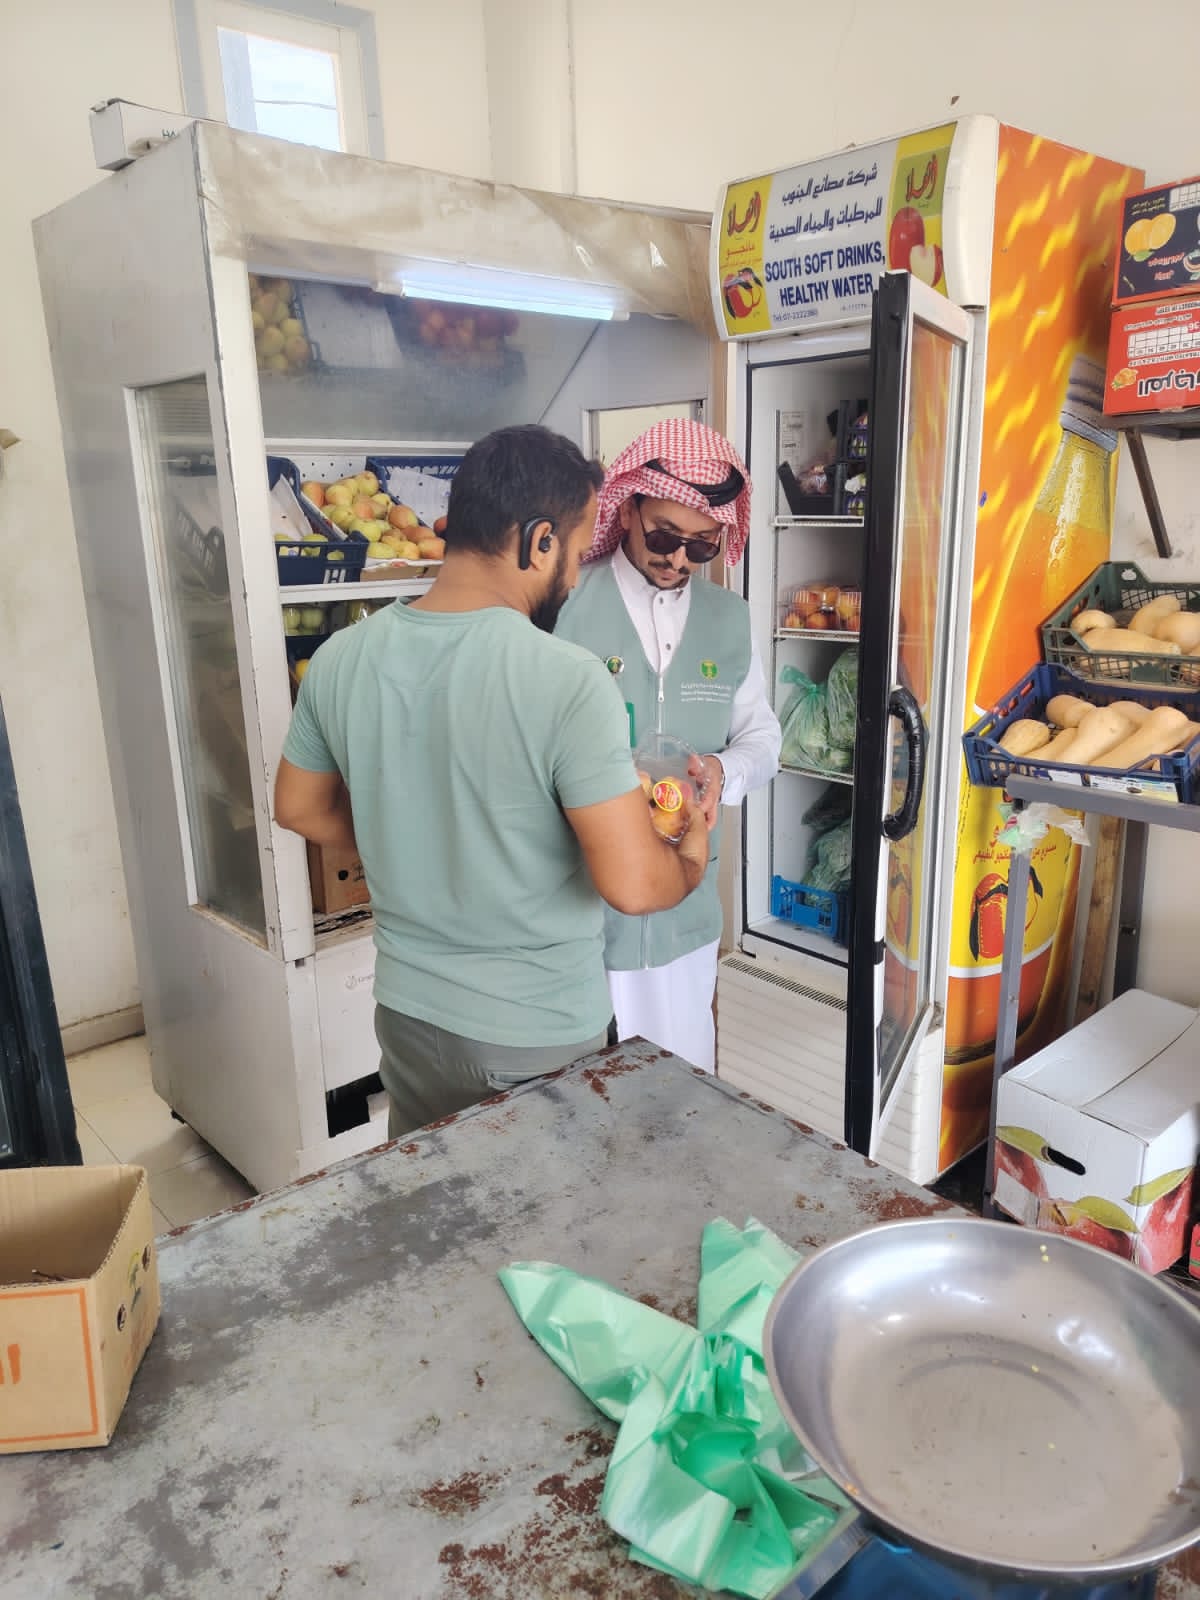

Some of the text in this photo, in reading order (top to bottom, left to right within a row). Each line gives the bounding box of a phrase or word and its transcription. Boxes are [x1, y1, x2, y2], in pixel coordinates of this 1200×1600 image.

[782, 162, 878, 206] شركة مصانع الجنوب
[769, 195, 883, 243] للمرطبات والمياه الصحية
[764, 256, 803, 282] SOUTH
[804, 249, 834, 275] SOFT
[837, 240, 886, 269] DRINKS,
[779, 279, 830, 307] HEALTHY
[1138, 369, 1200, 396] المرجا
